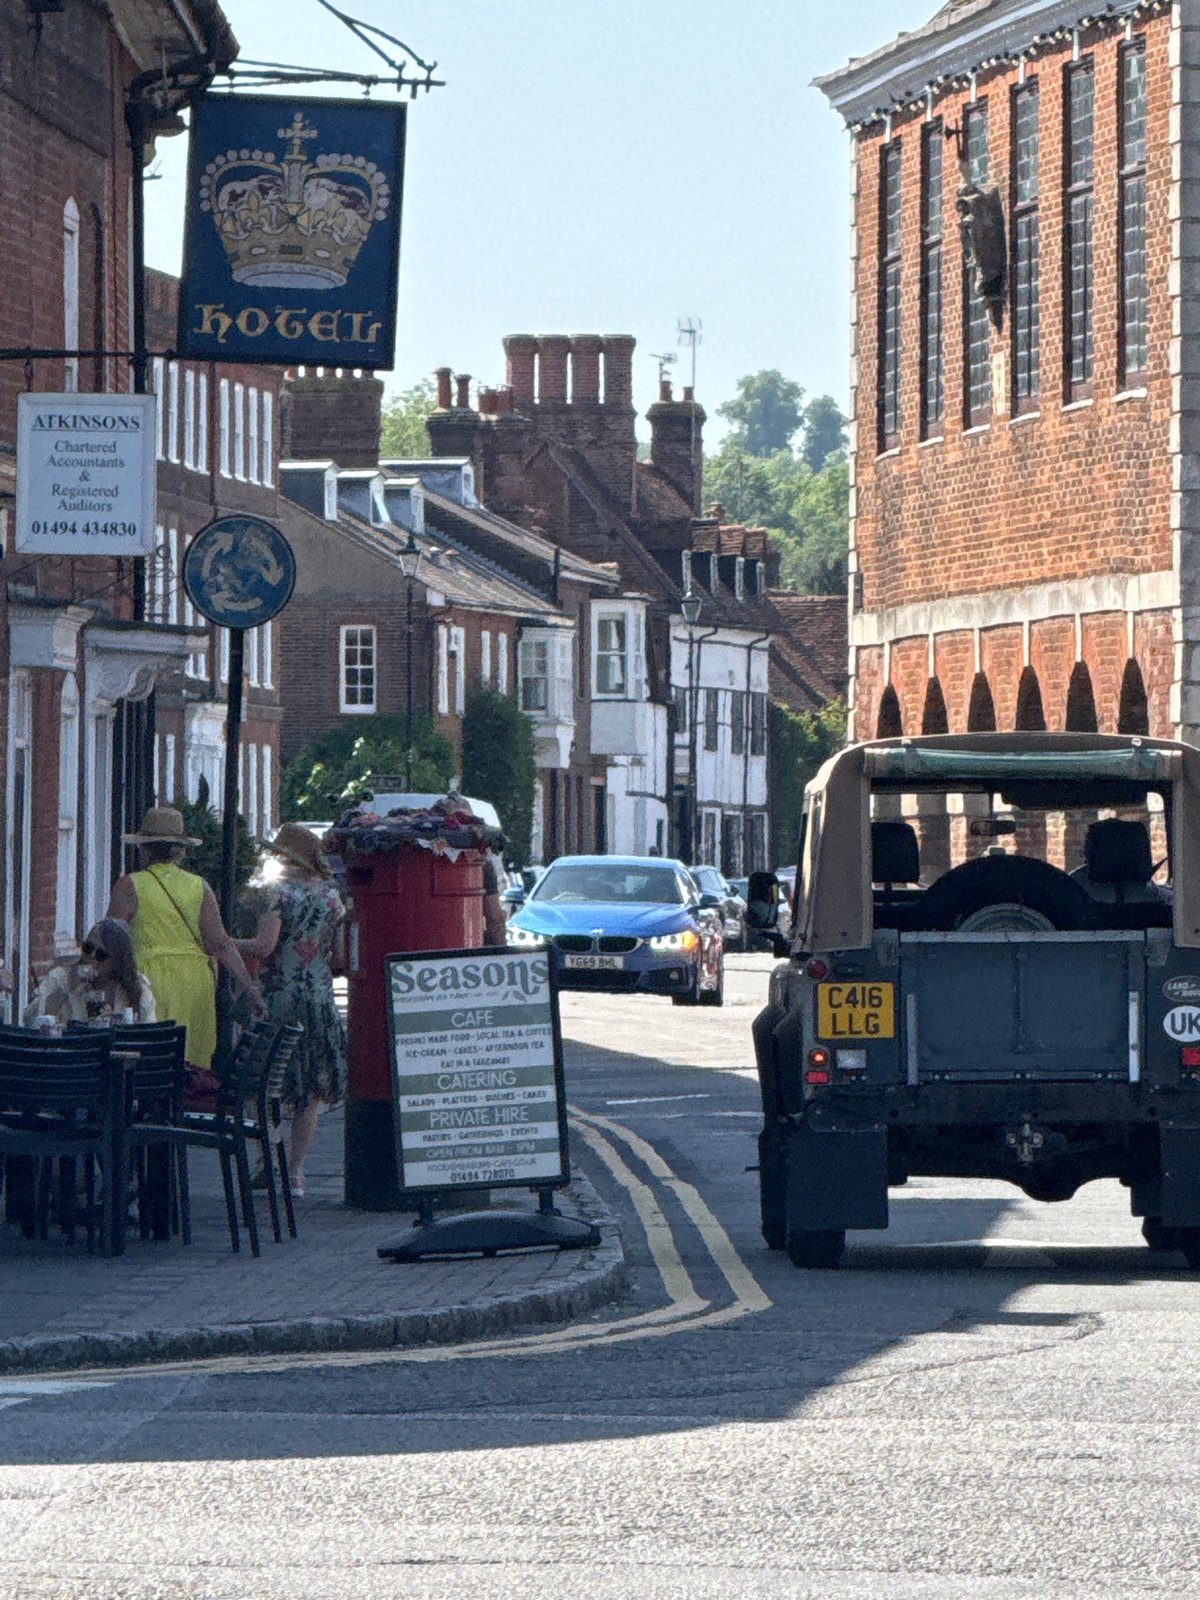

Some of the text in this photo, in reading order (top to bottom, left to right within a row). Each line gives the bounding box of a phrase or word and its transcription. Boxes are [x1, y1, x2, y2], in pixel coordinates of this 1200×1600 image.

[32, 414, 140, 430] ATKINSONS
[53, 440, 117, 453] Chartered
[47, 455, 126, 468] Accountants
[79, 470, 91, 482] &
[51, 483, 119, 498] Registered
[57, 498, 113, 512] Auditors
[31, 520, 136, 536] 01494 434830
[391, 960, 549, 996] Seasons
[828, 986, 883, 1009] C416
[451, 1010, 494, 1028] CAFE
[831, 1013, 880, 1035] LLG
[1171, 1012, 1200, 1035] UK
[437, 1070, 517, 1090] CATERING
[430, 1106, 529, 1128] PRIVATE HIRE
[450, 1171, 479, 1182] 01494
